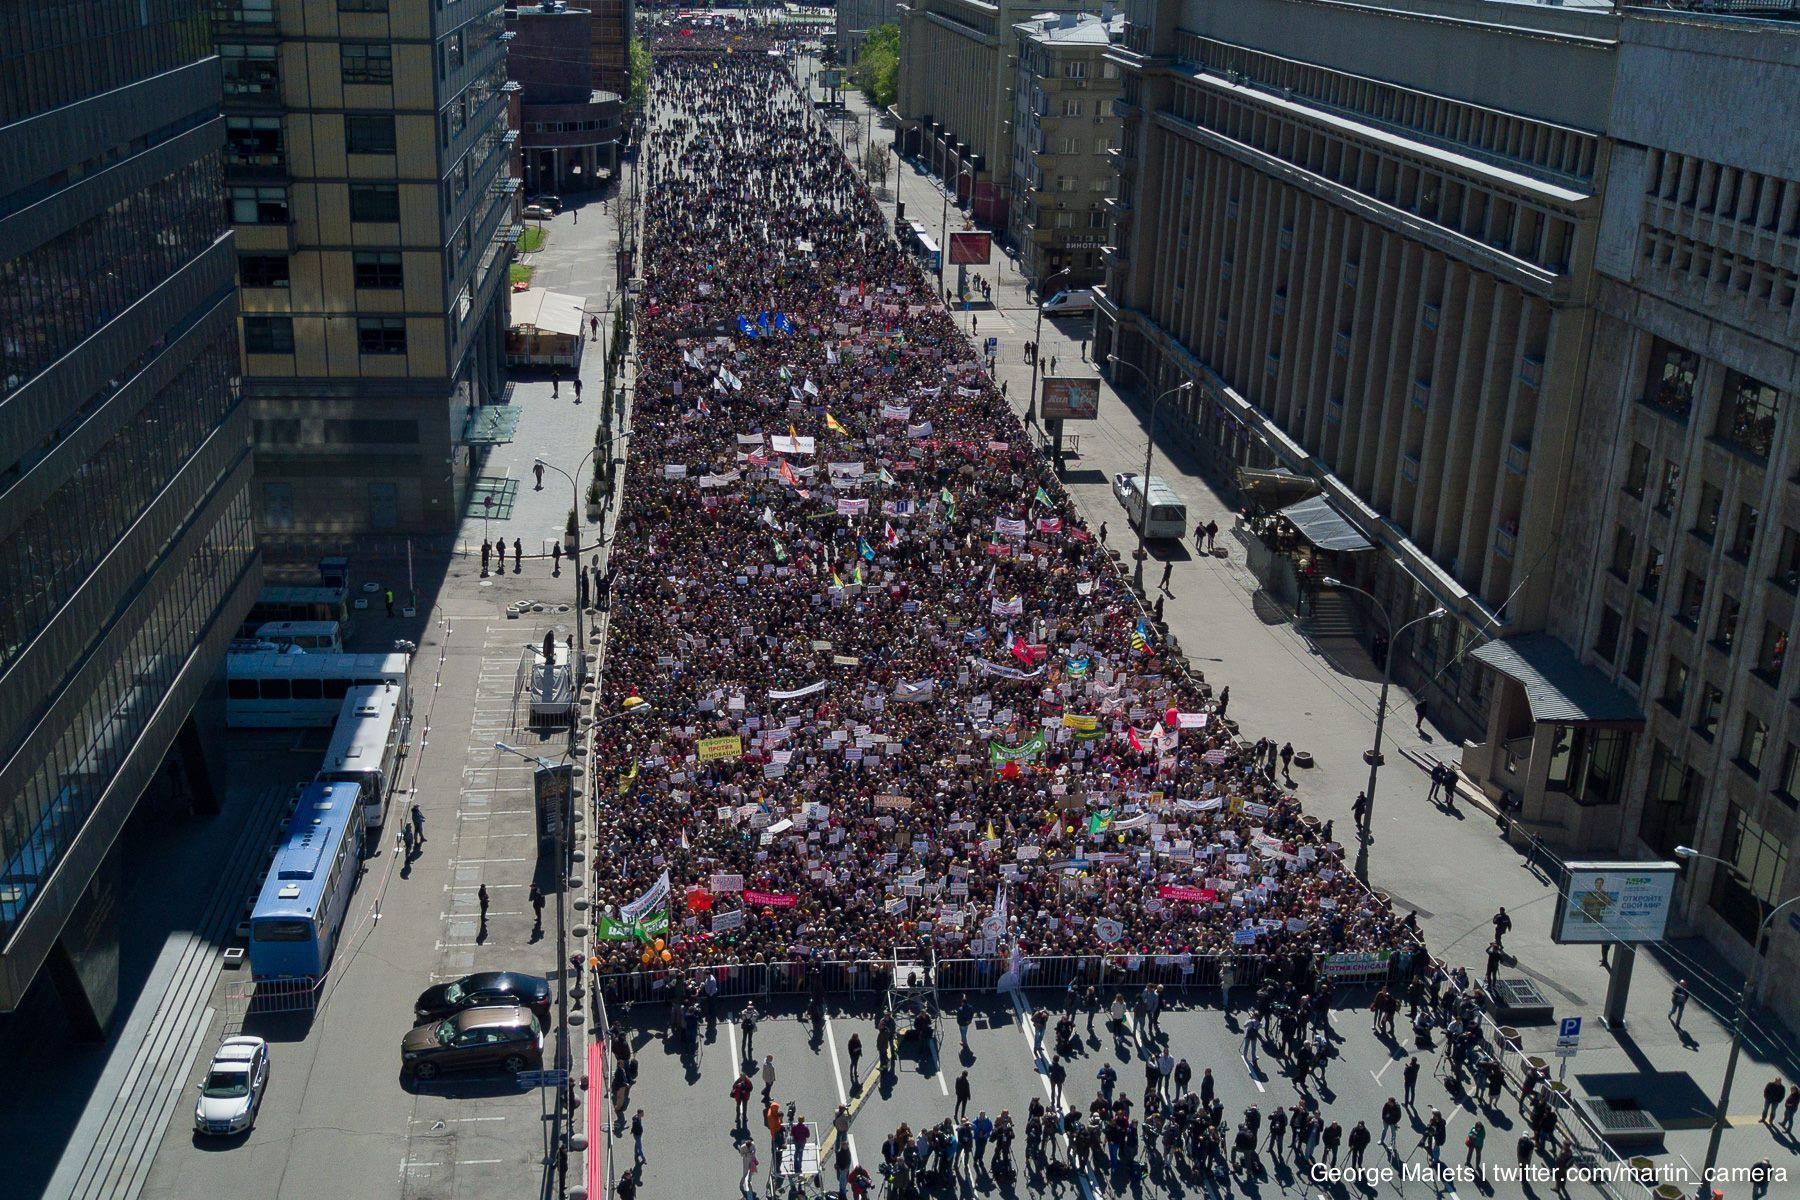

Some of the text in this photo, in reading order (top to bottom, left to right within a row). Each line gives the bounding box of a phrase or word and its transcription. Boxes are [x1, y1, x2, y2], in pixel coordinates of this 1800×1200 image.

[701, 738, 739, 747] ЛЕФОРТОВО
[708, 744, 733, 753] ПРОТИВ
[702, 750, 741, 759] РЕНОВАЦИИ
[1623, 894, 1664, 902] ОТКРОЙТЕ
[1621, 900, 1643, 909] СВОЙ
[1565, 1020, 1577, 1034] P
